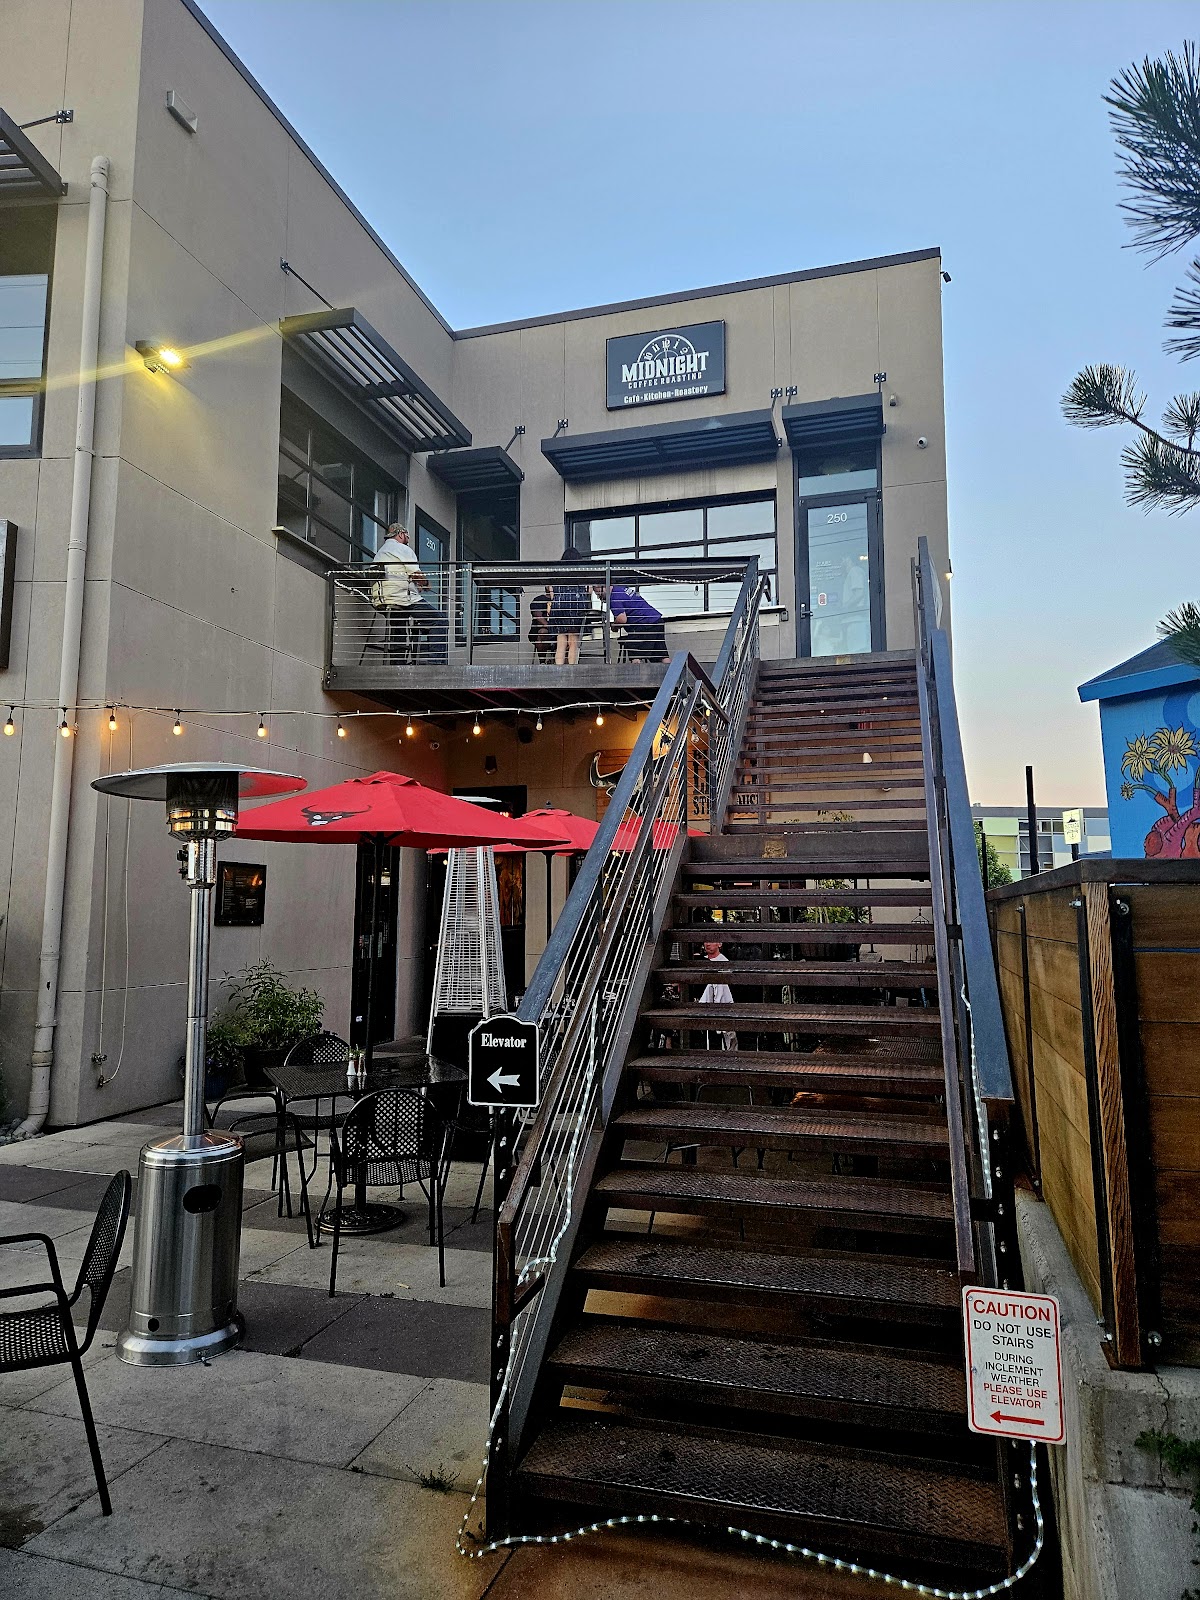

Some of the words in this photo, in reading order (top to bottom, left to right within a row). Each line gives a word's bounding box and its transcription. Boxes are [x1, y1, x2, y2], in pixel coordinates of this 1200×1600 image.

[621, 351, 709, 382] MIDNIGHT
[628, 378, 658, 389] COFFEE
[660, 372, 702, 385] ROASTING
[643, 391, 672, 401] Kitchen
[674, 385, 708, 397] Roastery
[826, 512, 848, 524] 250
[426, 537, 436, 551] 250
[481, 1033, 527, 1048] Elevator
[973, 1299, 1051, 1321] CAUTION
[973, 1319, 991, 1331] DO
[997, 1322, 1021, 1335] NOT
[1026, 1326, 1052, 1339] USE
[992, 1335, 1034, 1349] STAIRS
[994, 1351, 1034, 1365] DURING
[985, 1361, 1044, 1377] INCLEMENT
[991, 1372, 1040, 1387] WEATHER
[983, 1382, 1023, 1396] PLEASE
[1026, 1388, 1048, 1399] USE
[991, 1394, 1041, 1410] ELEVATOR
